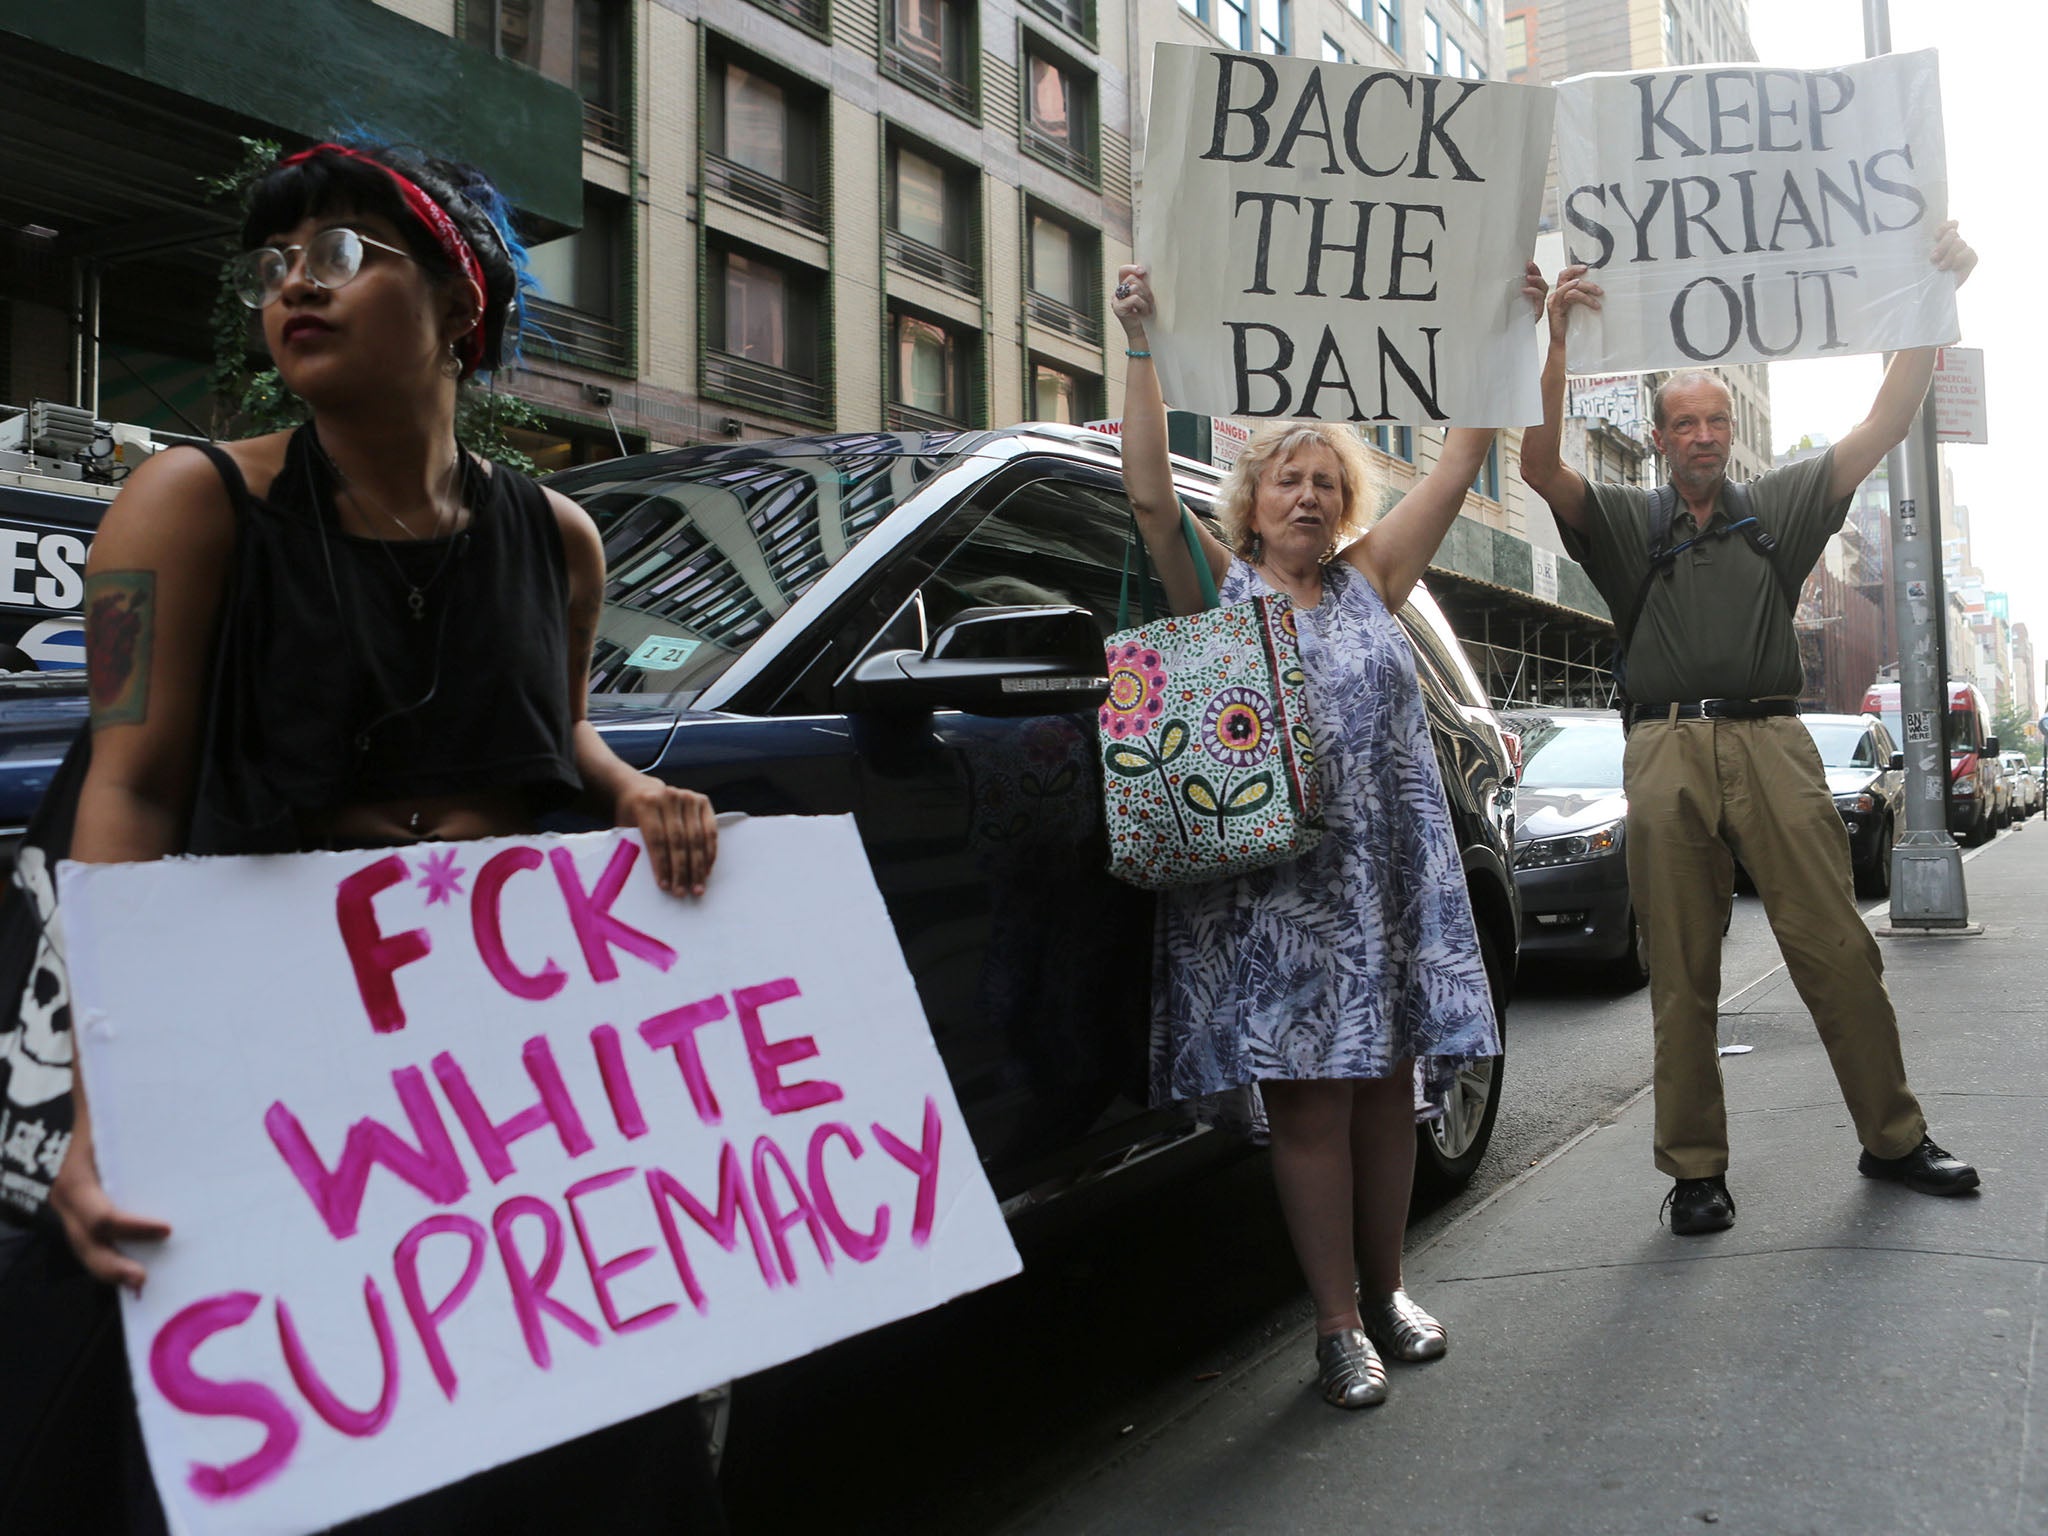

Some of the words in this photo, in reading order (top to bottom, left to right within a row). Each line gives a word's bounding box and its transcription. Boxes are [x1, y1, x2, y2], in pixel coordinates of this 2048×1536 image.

[1199, 52, 1487, 183] BACK
[1630, 70, 1856, 162] KEEP
[1235, 190, 1447, 302] THE
[1565, 144, 1929, 270] SYRIANS
[1669, 265, 1858, 362] OUT
[1222, 321, 1451, 423] BAN
[1213, 417, 1248, 442] DANGER
[0, 528, 94, 610] ES
[661, 648, 685, 662] 21
[1909, 732, 1930, 740] HERE
[263, 977, 844, 1241] WHITE
[147, 1093, 942, 1503] SUPREMACY
